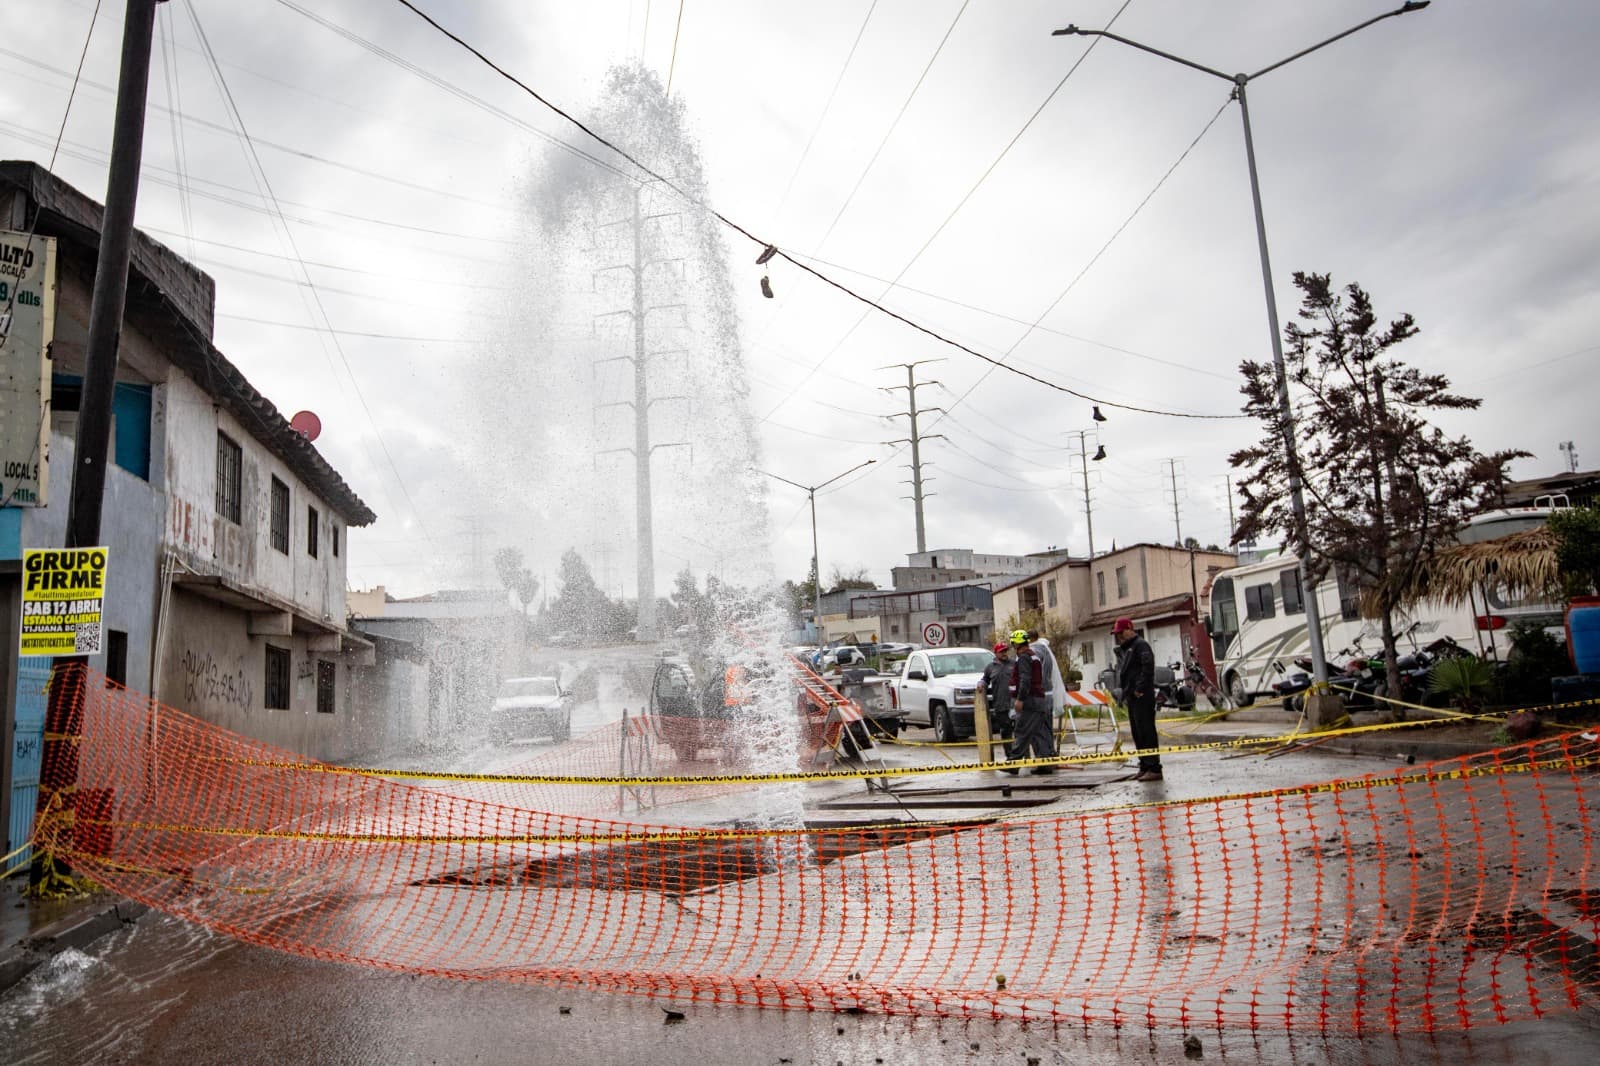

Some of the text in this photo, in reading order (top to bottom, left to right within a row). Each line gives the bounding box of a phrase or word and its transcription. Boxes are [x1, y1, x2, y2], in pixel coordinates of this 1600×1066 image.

[18, 290, 41, 306] dlls
[5, 461, 31, 480] LOCAL
[26, 551, 105, 572] GRUPO
[27, 570, 102, 592] FIRME
[24, 599, 100, 616] SAB 12 ABRIL
[24, 613, 100, 626] ESTADIO CALIENTE
[24, 625, 63, 633] TIJUANA
